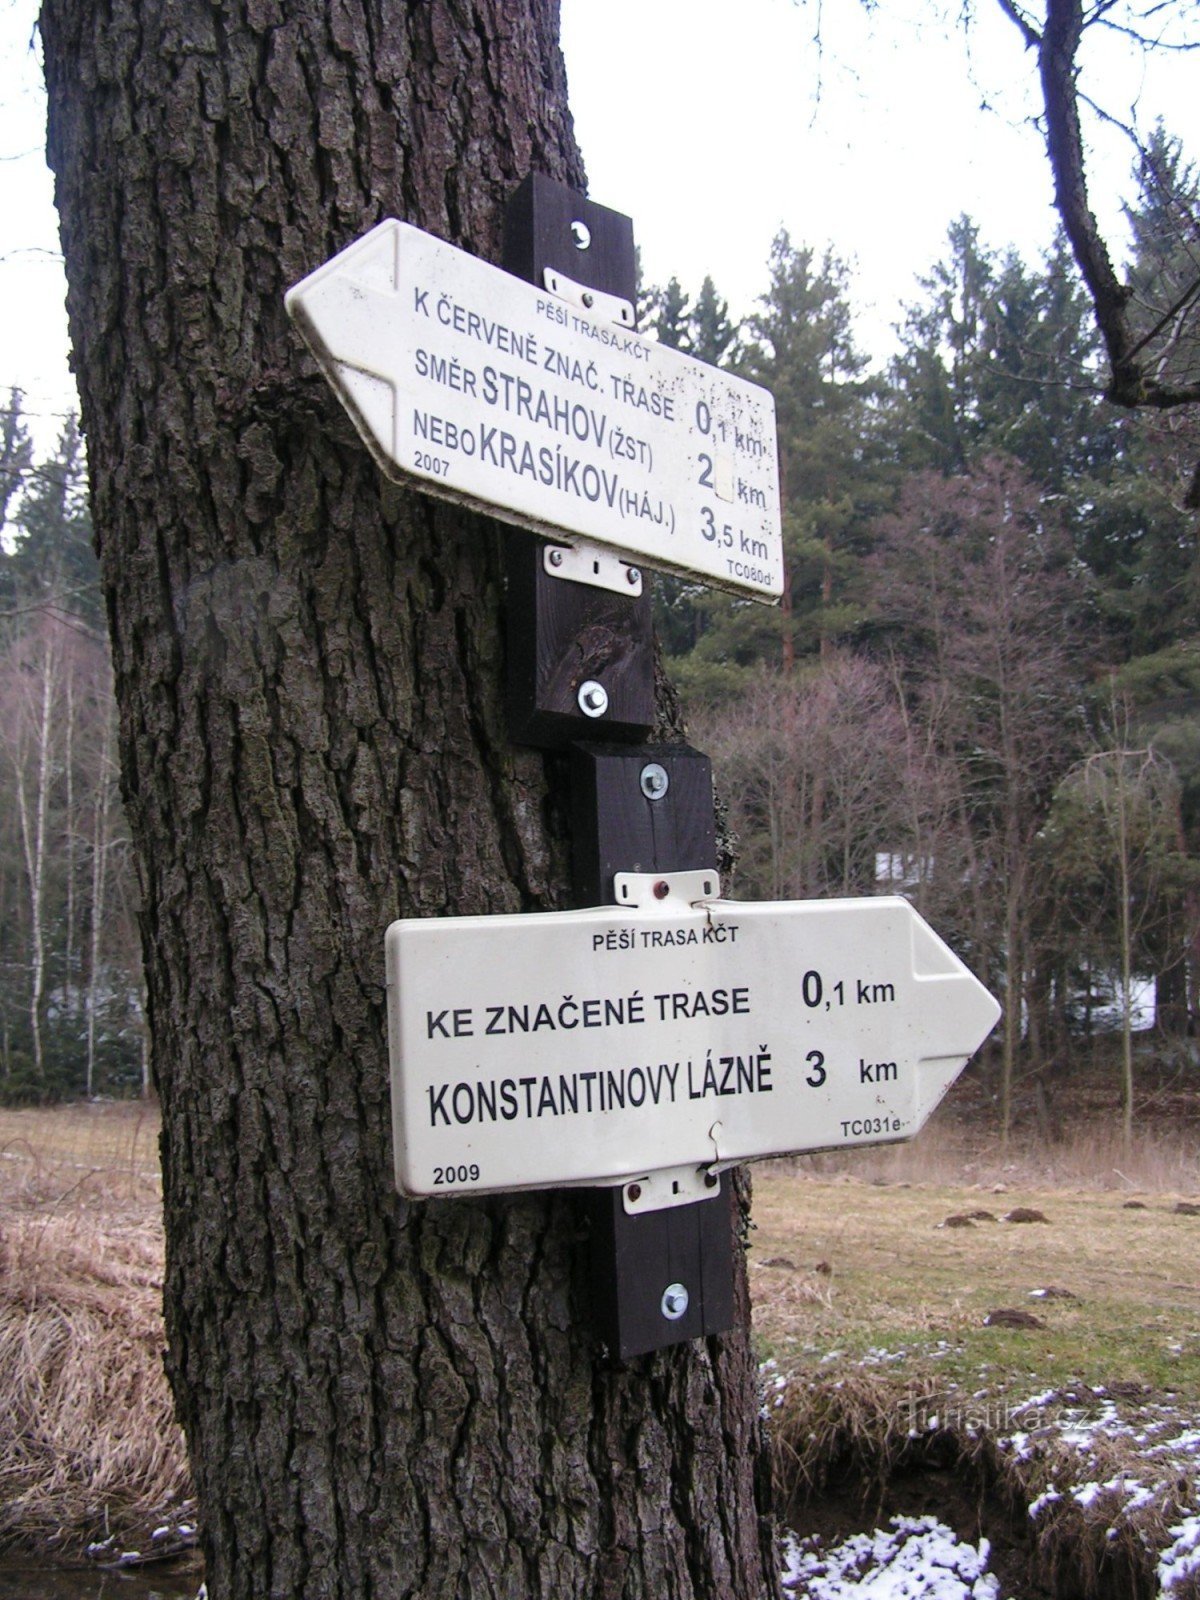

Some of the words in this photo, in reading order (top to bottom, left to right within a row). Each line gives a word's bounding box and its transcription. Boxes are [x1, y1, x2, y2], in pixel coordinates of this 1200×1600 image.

[537, 299, 568, 327] PĚŠÍ
[572, 316, 623, 350] TRASA
[624, 341, 651, 362] KČT
[414, 286, 429, 317] K
[437, 292, 538, 365] ČERVENĚ
[544, 346, 604, 393] ZNAČ.
[610, 374, 675, 422] TRASE
[696, 400, 727, 446] 0,1
[735, 426, 763, 456] km
[415, 348, 477, 398] SMĚR
[698, 453, 714, 489] 2
[737, 477, 766, 508] km
[413, 408, 476, 456] NEBO
[700, 506, 733, 548] 3,5
[740, 530, 768, 560] km
[414, 450, 450, 477] 2007
[726, 559, 771, 586] TC080d
[592, 929, 635, 951] PĚŠÍ
[641, 929, 698, 948] TRASA
[702, 923, 739, 945] KČT
[427, 1008, 474, 1039] KE
[485, 990, 645, 1035] ZNAČENÉ
[654, 987, 750, 1021] TRASE
[802, 970, 844, 1012] 0,1
[857, 979, 895, 1004] km
[428, 1062, 680, 1127] KONSTANTINOVY
[687, 1044, 773, 1100] LÁZNĚ
[805, 1050, 827, 1088] 3
[859, 1058, 898, 1084] km
[840, 1116, 900, 1137] TC031e
[433, 1164, 480, 1185] 2009
